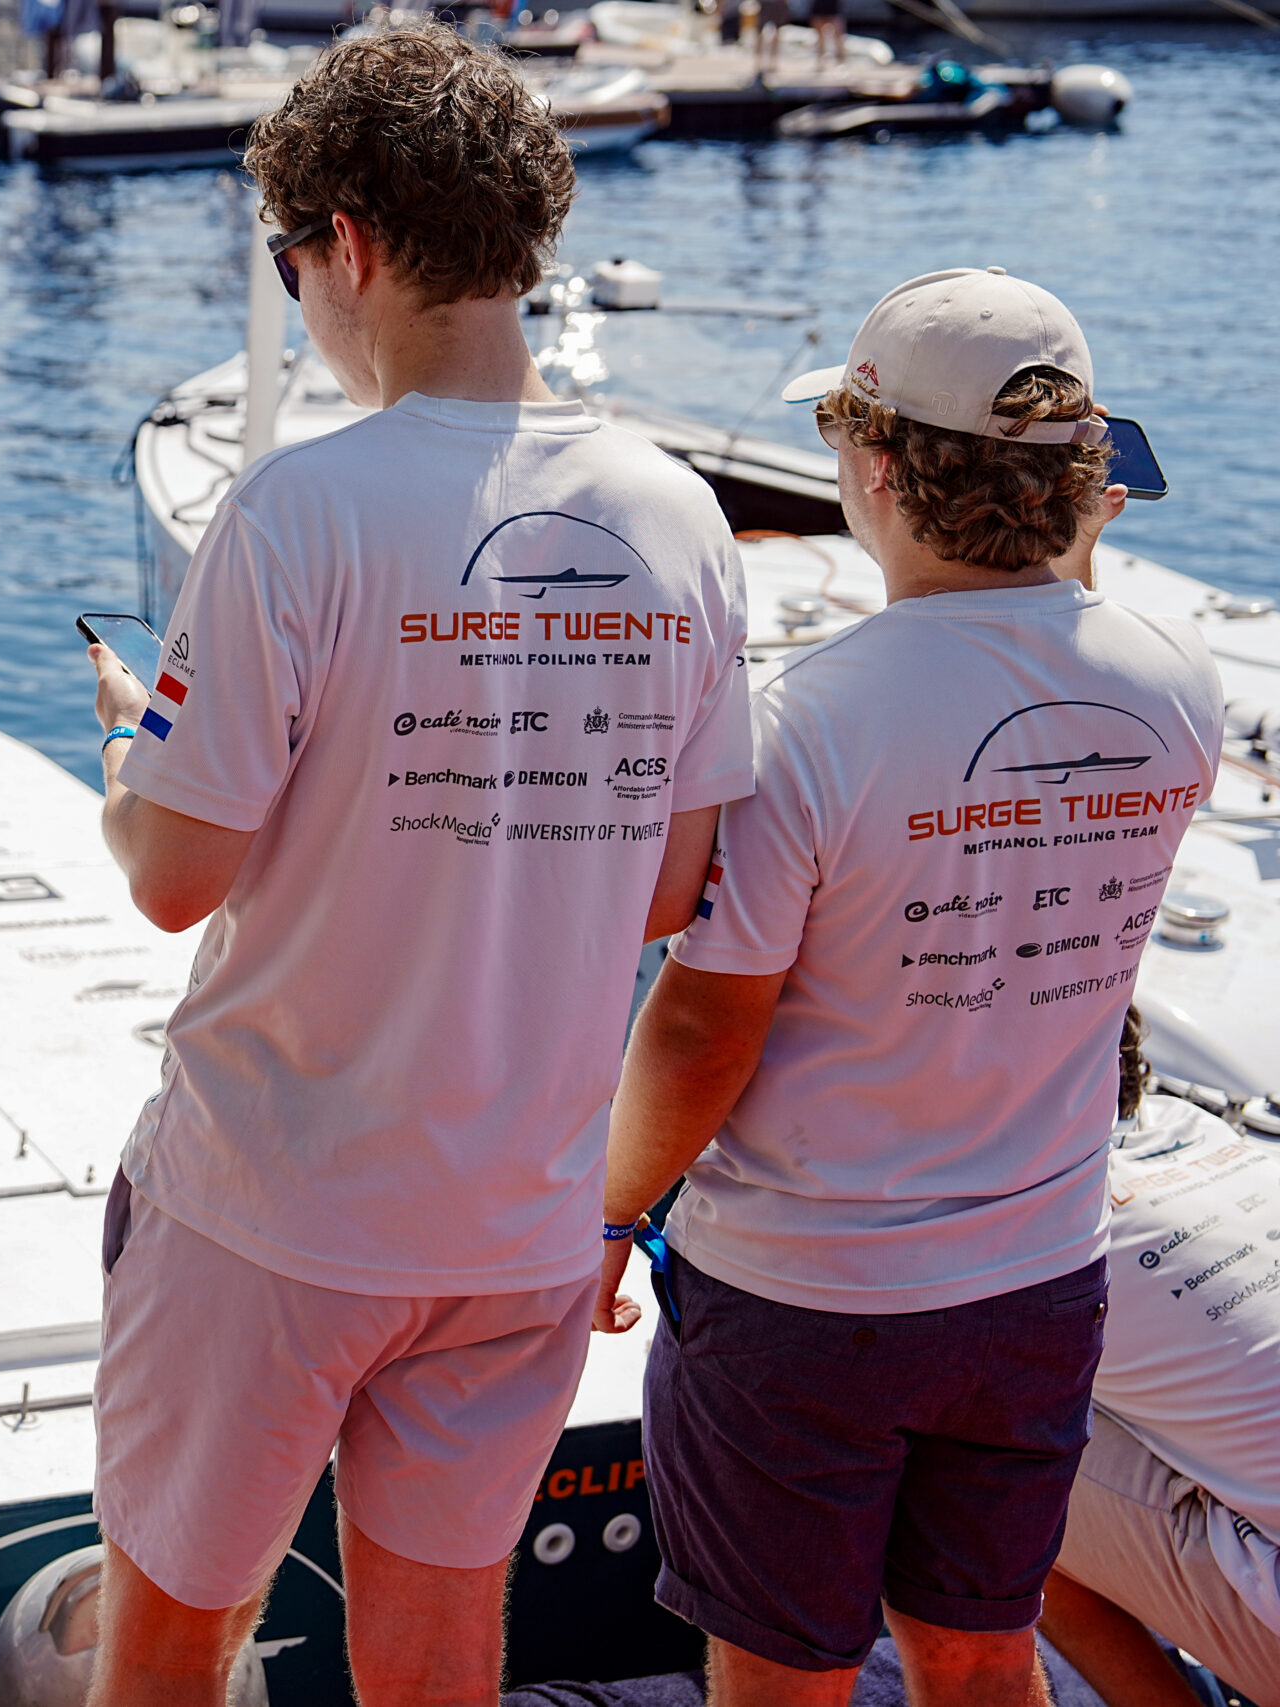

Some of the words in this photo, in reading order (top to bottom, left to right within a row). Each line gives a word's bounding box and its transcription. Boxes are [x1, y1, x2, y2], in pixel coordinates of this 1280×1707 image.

[400, 612, 520, 643] SURGE
[535, 612, 691, 644] TWENTE
[527, 653, 597, 665] FOILING
[603, 653, 651, 665] TEAM
[420, 709, 462, 729] café
[466, 713, 501, 729] noir
[510, 711, 549, 733] ETC
[518, 770, 588, 787] DEMCON
[614, 757, 667, 777] ACES
[405, 768, 498, 790] Benchmark
[908, 798, 1041, 841] SURGE
[1060, 783, 1199, 822] TWENTE
[506, 823, 595, 842] UNIVERSITY
[598, 824, 616, 840] OF
[963, 836, 1048, 855] METHANOL
[1053, 830, 1116, 846] FOILING
[1121, 825, 1159, 840] TEAM
[933, 895, 971, 916] café
[975, 892, 1003, 911] noir
[1033, 887, 1070, 910] ETC
[1121, 905, 1157, 932] ACES
[918, 945, 997, 966] Benchmark
[1046, 934, 1100, 956] DEMCON
[1029, 978, 1103, 1006] UNIVERSITY
[1104, 972, 1118, 989] OF
[1111, 1168, 1190, 1211] URGE
[1160, 1226, 1191, 1254] café
[1184, 1242, 1257, 1291] Benchmark
